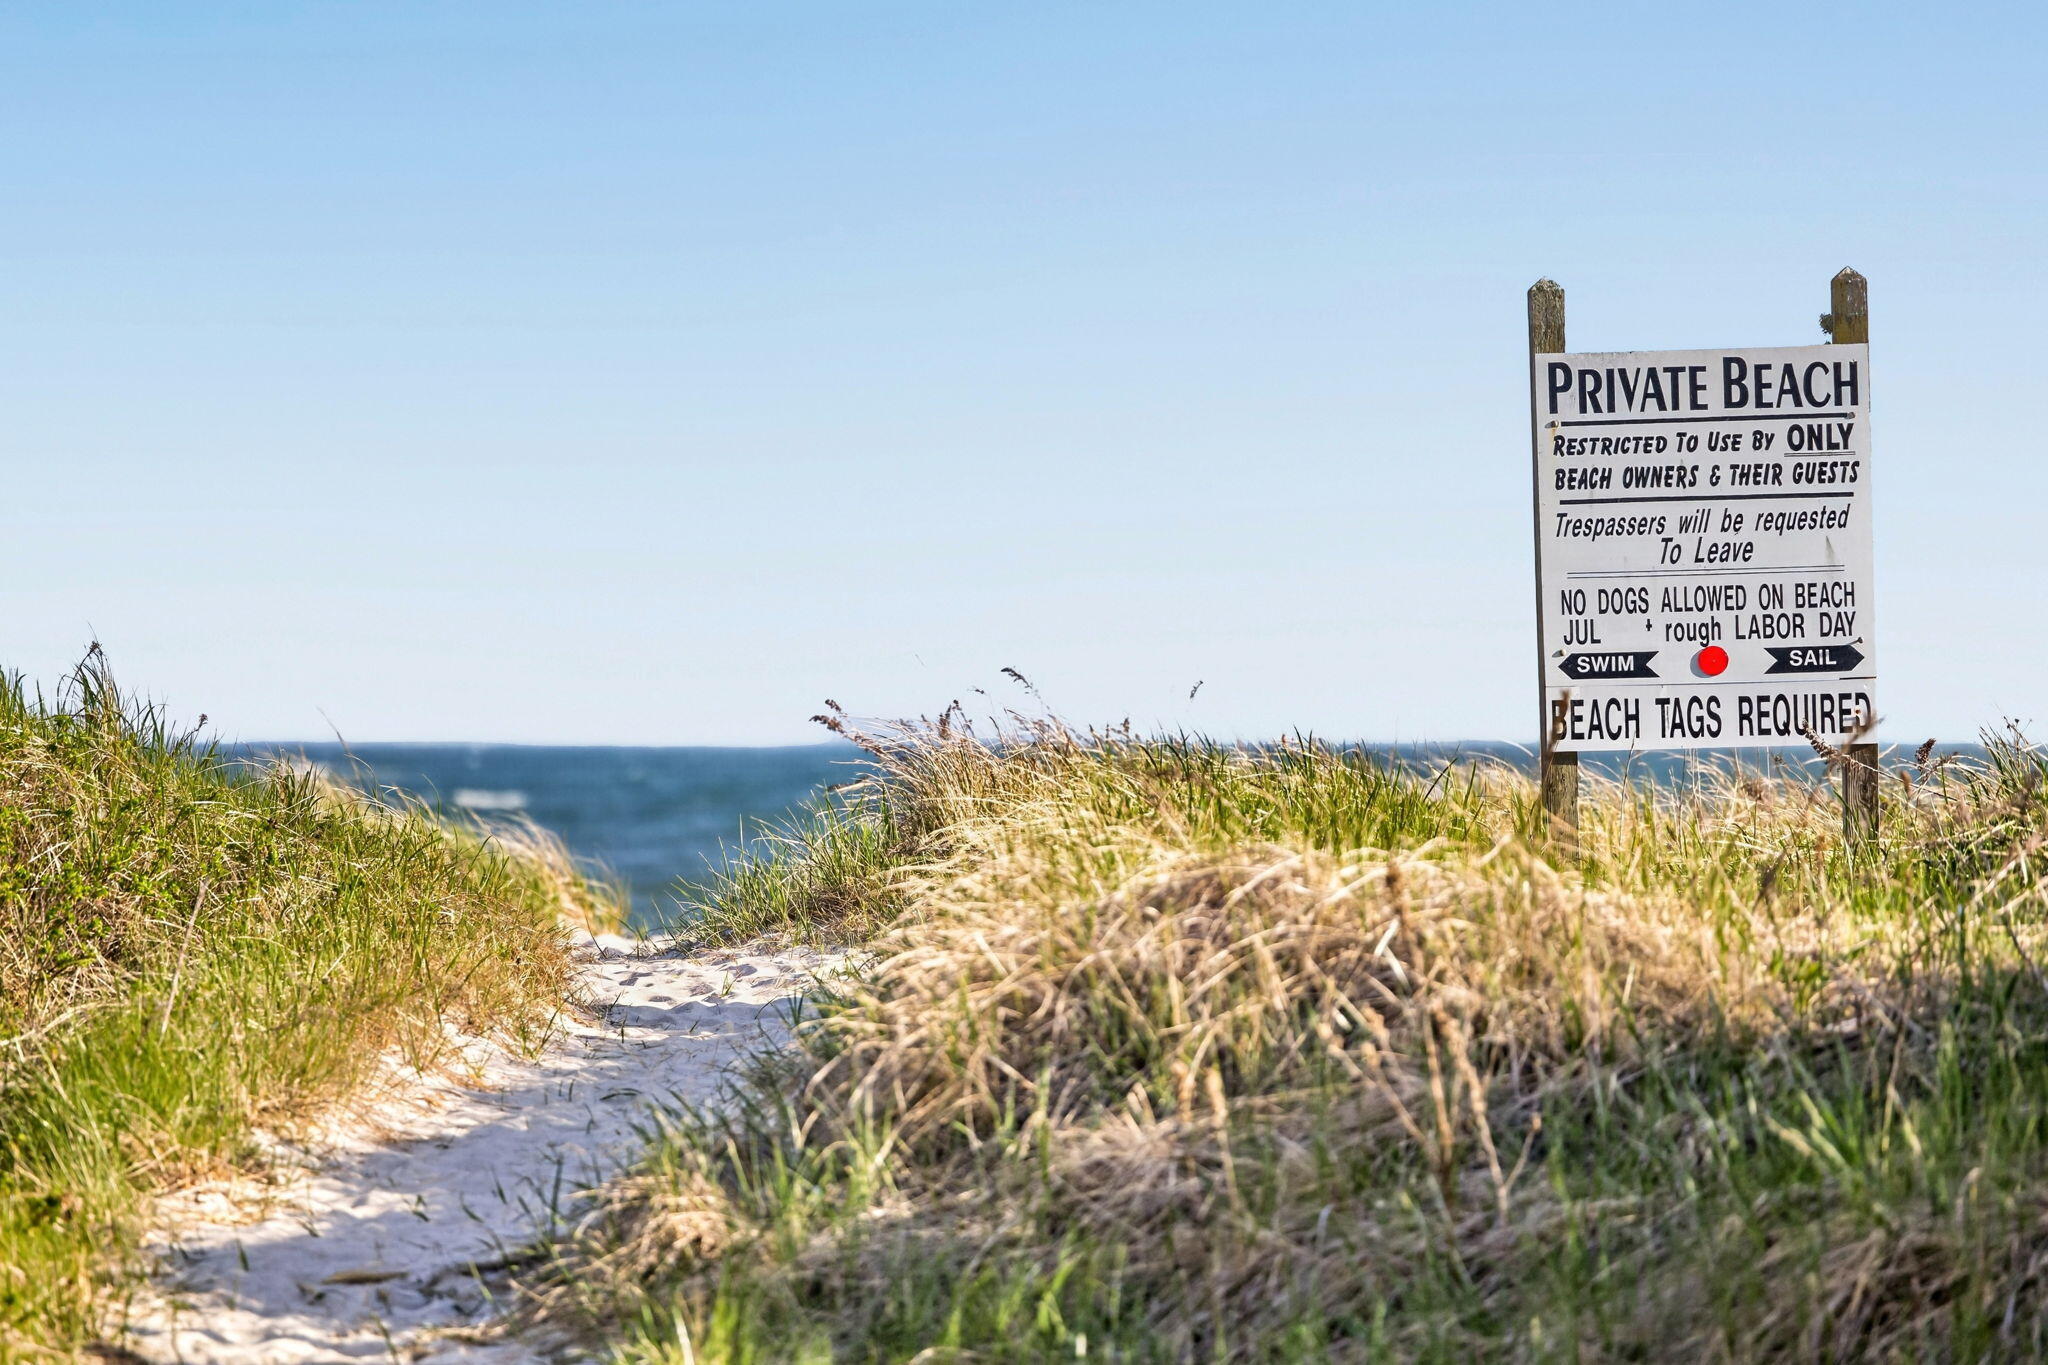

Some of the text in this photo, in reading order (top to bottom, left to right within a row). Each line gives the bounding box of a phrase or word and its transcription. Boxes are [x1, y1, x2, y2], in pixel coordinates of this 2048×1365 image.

[1787, 423, 1854, 451] ONLY
[1555, 461, 1859, 490] BEACH OWNERS & THEIR GUESTS
[1555, 503, 1850, 542] Trespassers will be requested
[1660, 537, 1753, 565] To Leave
[1561, 581, 1855, 616] NO DOGS ALLOWED ON BEACH
[1735, 613, 1805, 640] LABOR
[1820, 611, 1856, 637] DAY
[1577, 655, 1634, 673] SWIM
[1789, 649, 1837, 666] SAIL
[1552, 692, 1871, 740] BEACH TAGS REQUIRED
